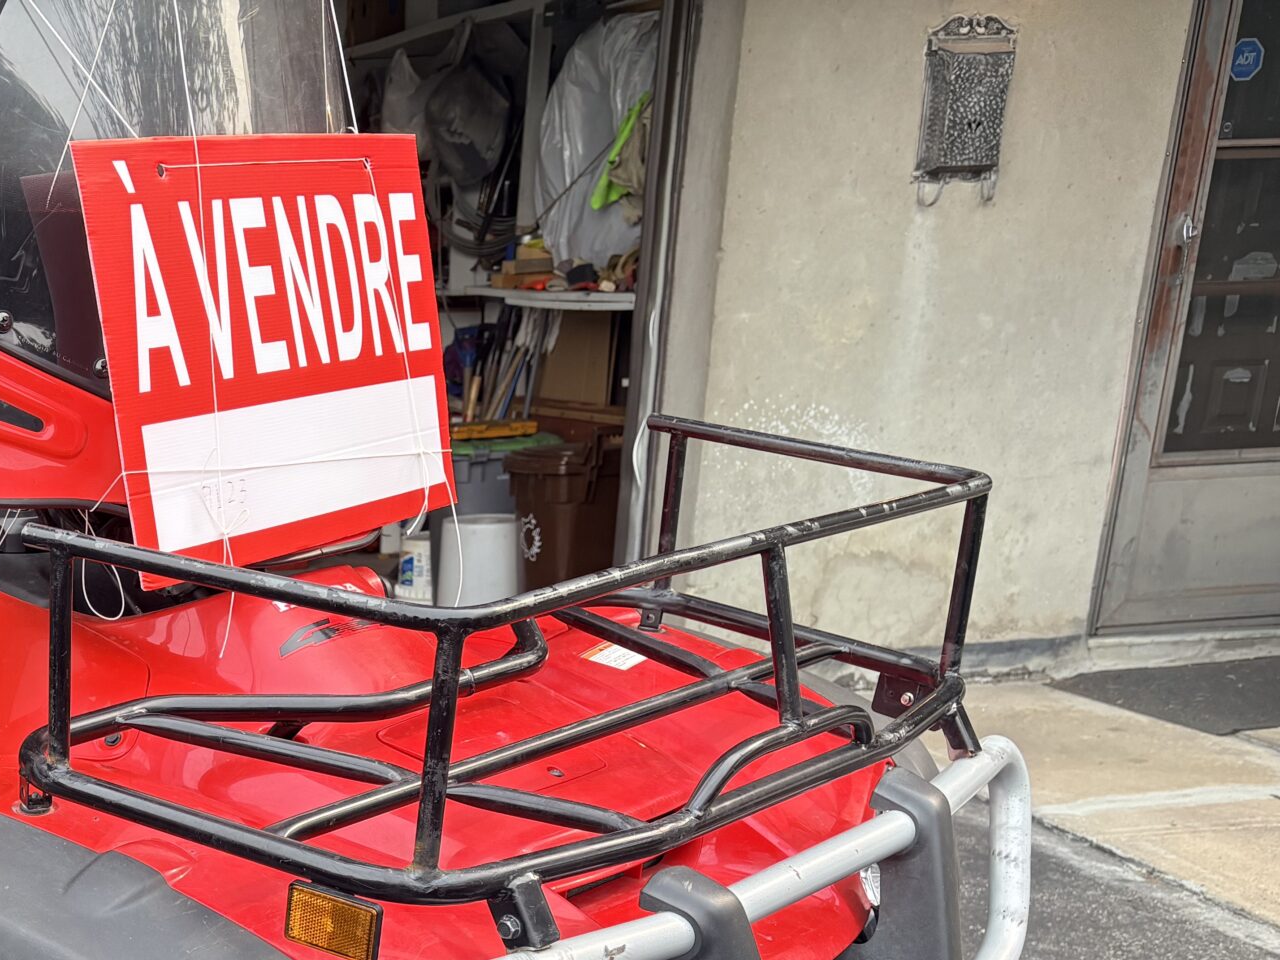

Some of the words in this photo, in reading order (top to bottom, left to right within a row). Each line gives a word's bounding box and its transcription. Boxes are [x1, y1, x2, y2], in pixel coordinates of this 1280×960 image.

[1235, 52, 1257, 65] ADT
[111, 159, 191, 393] À
[177, 192, 432, 380] VENDRE
